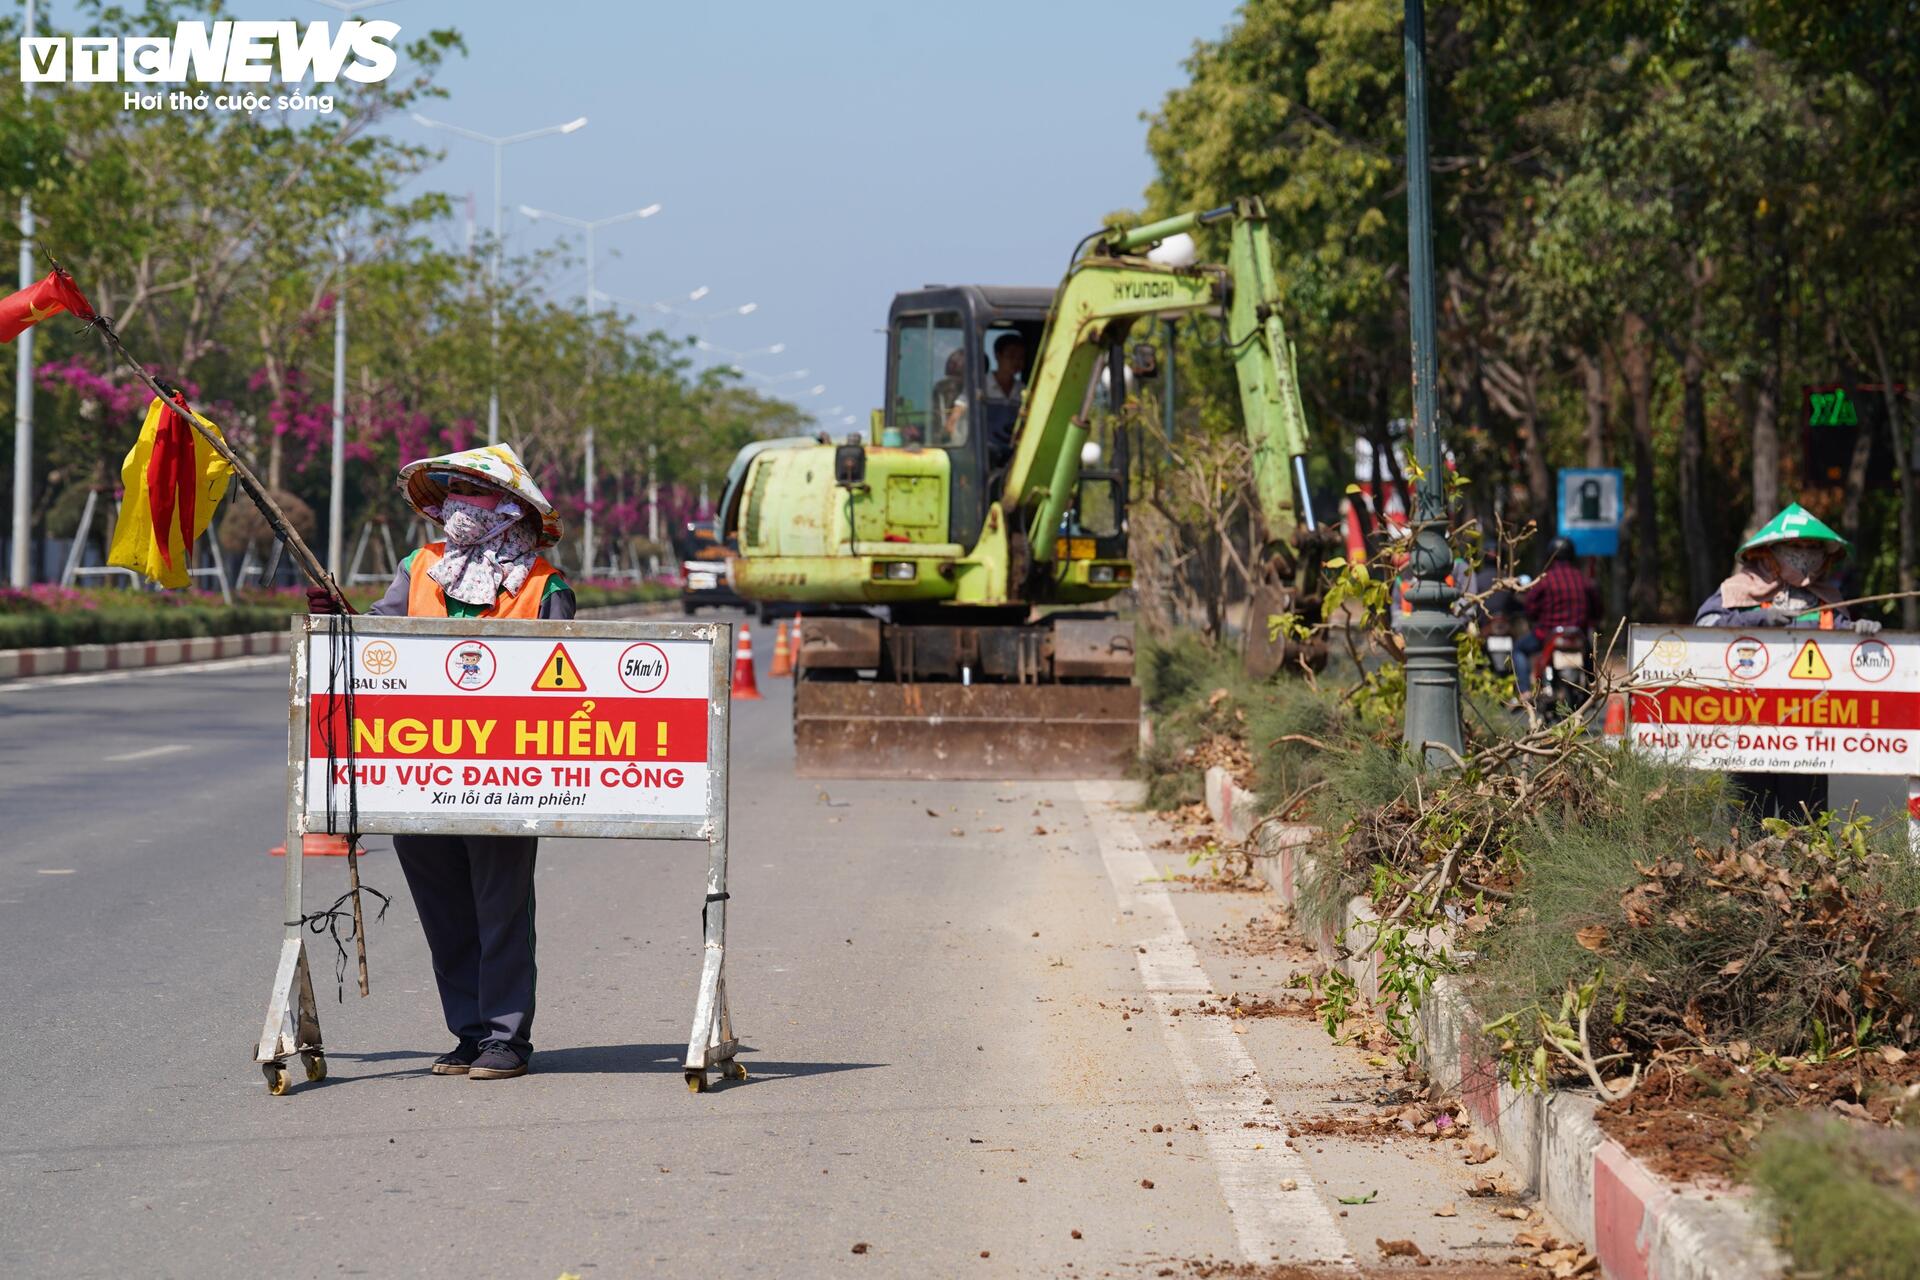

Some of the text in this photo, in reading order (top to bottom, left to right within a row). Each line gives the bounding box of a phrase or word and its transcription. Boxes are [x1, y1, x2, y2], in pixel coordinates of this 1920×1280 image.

[1114, 281, 1174, 299] HYUNDAI
[624, 659, 662, 677] 5Km/h
[351, 678, 408, 690] BAU SEN
[1669, 695, 1766, 724] NGUY
[1871, 699, 1879, 725] !
[353, 700, 668, 757] NGUY HIỂM !
[1638, 732, 1678, 748] KHU
[1737, 734, 1798, 751] ĐANG
[1805, 736, 1836, 752] THI
[1843, 732, 1908, 754] CÔNG
[333, 762, 685, 791] KHU VỰC ĐANG THI CÔNG
[431, 790, 587, 808] Xin lỗi đã làm phiền!
